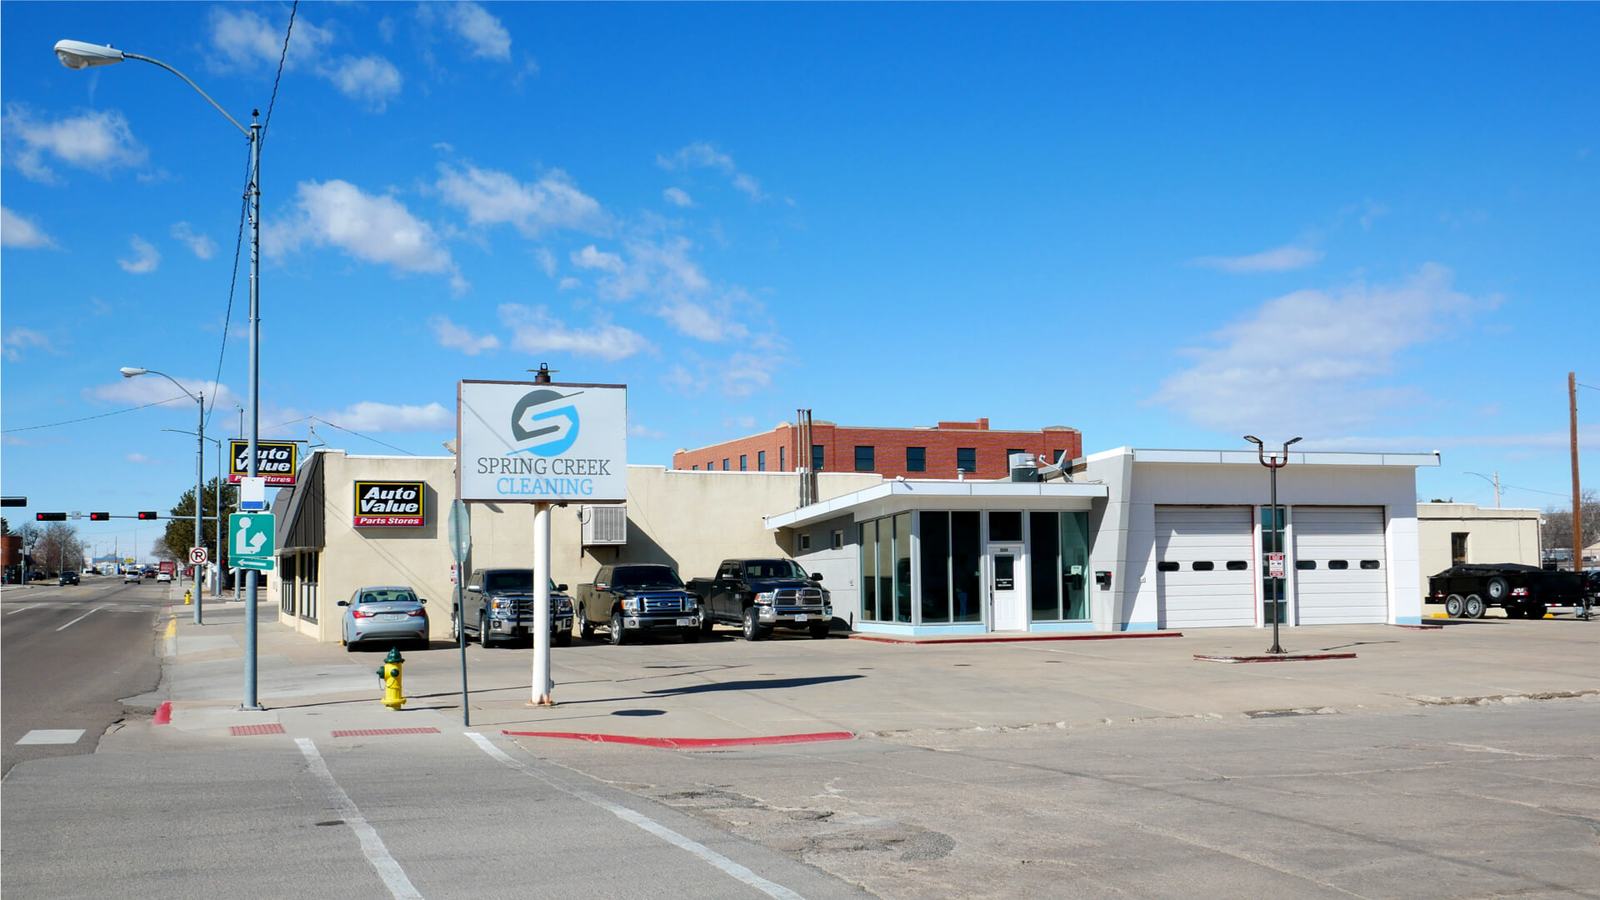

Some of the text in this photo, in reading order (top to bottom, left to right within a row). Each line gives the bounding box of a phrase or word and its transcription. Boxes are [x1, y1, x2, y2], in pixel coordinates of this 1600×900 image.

[235, 458, 291, 472] Vlue
[477, 457, 612, 476] SPRING CREEK
[363, 486, 417, 500] Auto
[496, 477, 593, 496] CLEANING
[360, 499, 419, 513] Value
[359, 517, 420, 525] Parts Stores
